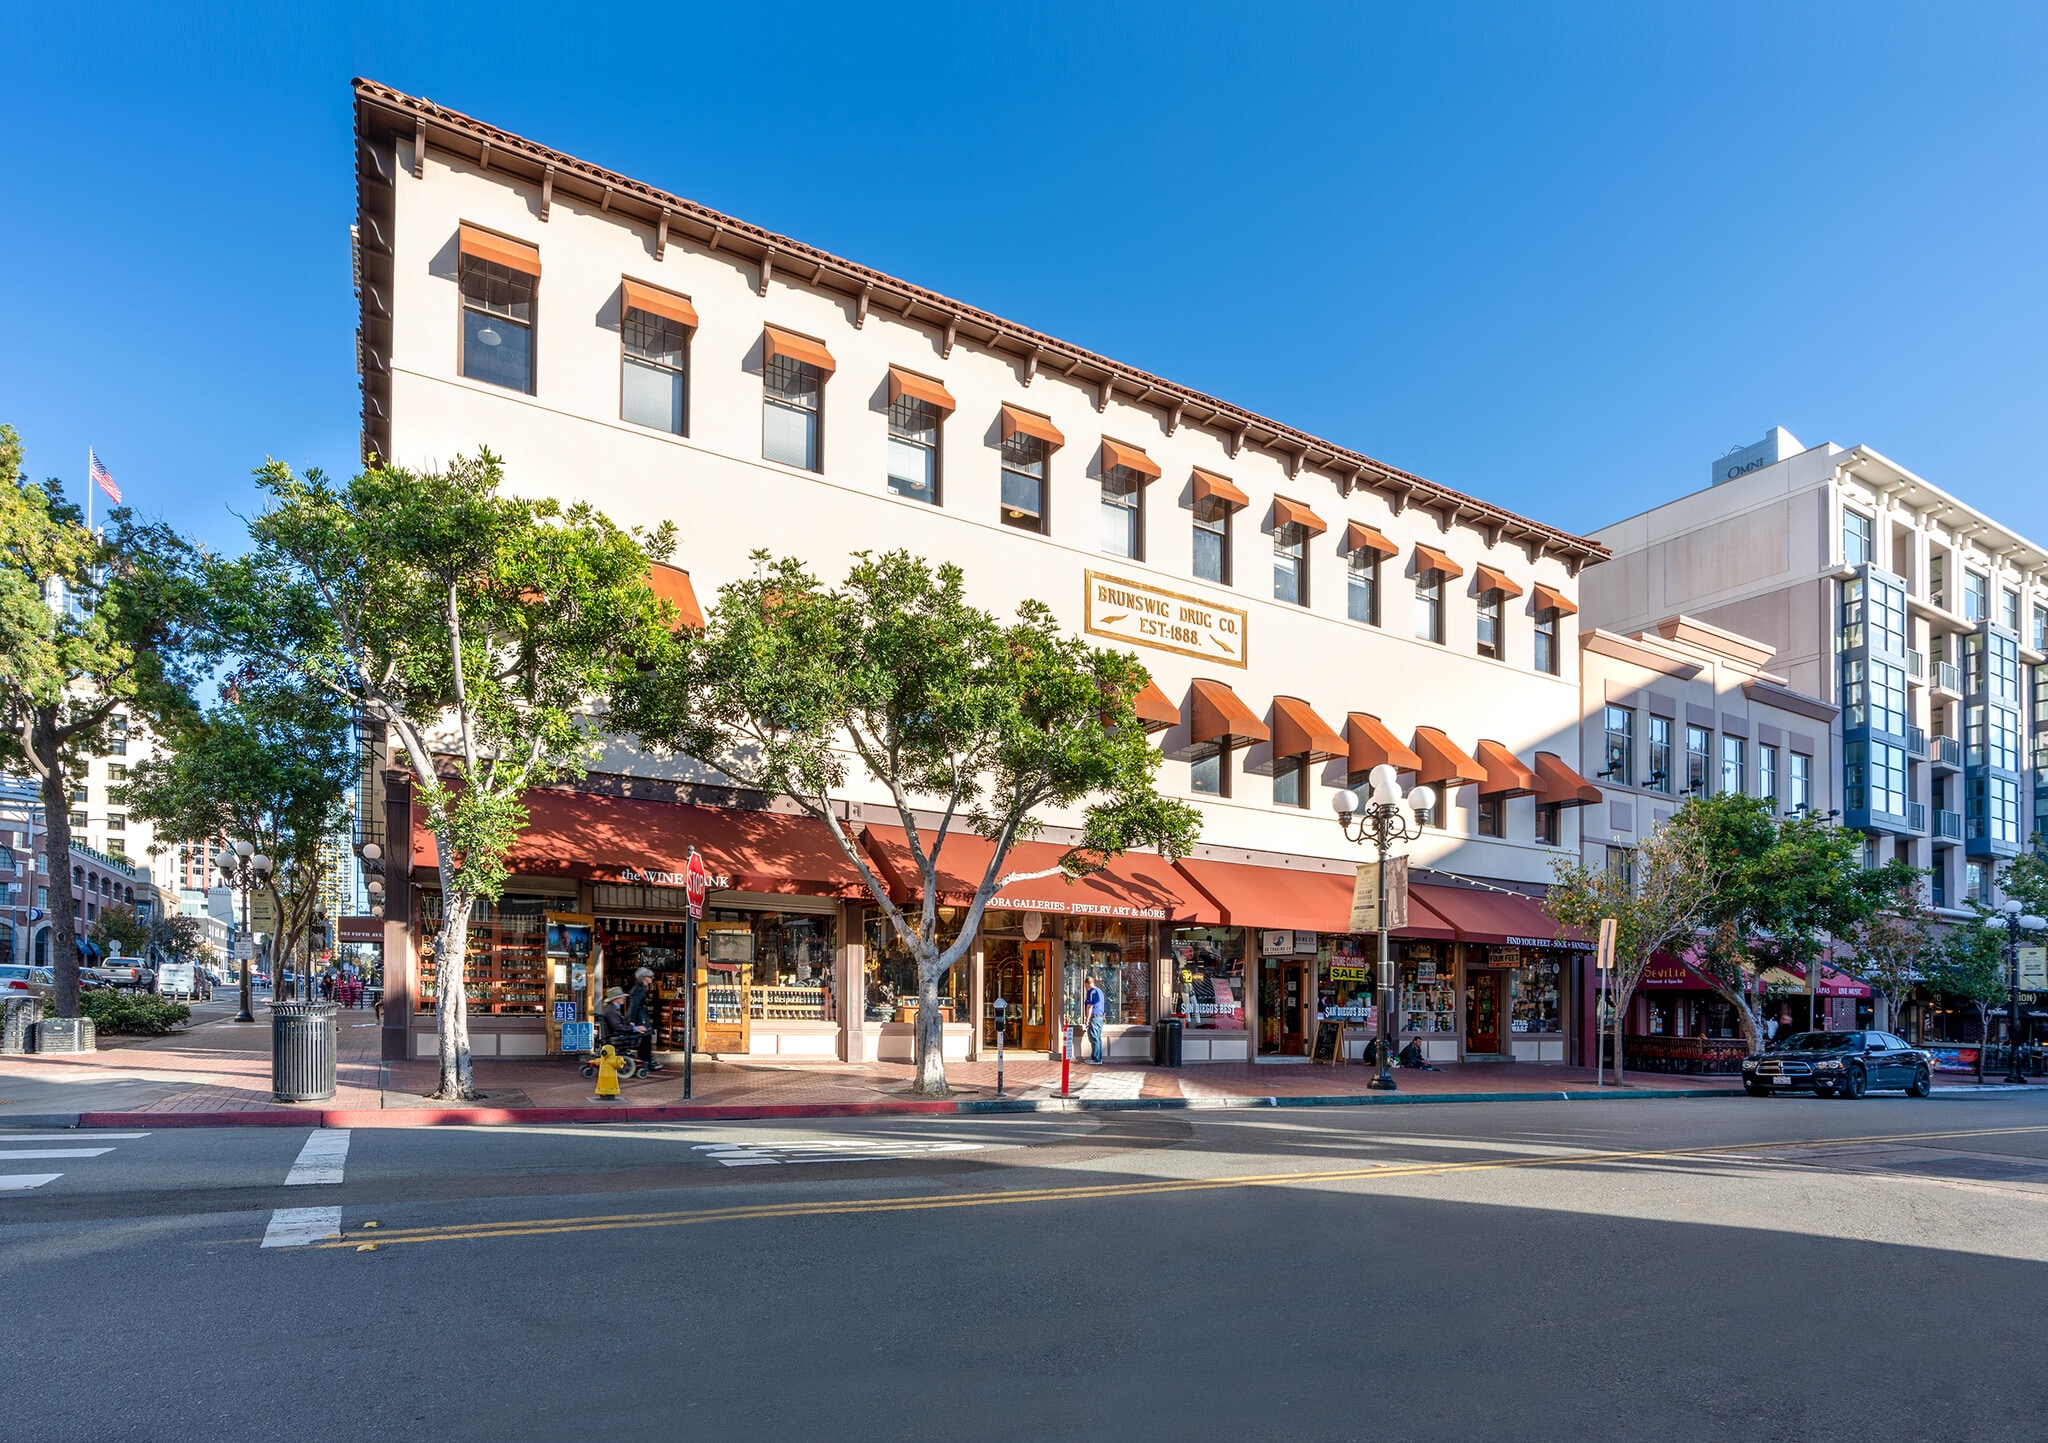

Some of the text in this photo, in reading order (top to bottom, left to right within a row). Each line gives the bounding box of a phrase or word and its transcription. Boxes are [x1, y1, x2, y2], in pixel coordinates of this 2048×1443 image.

[1727, 457, 1764, 479] OMNI
[1098, 585, 1238, 635] BRUNSWIG DRUG CO.
[621, 869, 641, 881] the
[644, 870, 684, 885] WINE
[688, 869, 704, 895] STOP
[1013, 898, 1065, 911] GALLERIES
[1071, 903, 1112, 915] JEWELRY
[1113, 906, 1131, 916] ART
[1131, 907, 1139, 917] &
[1139, 908, 1166, 919] MORE
[1506, 936, 1521, 945] FIND
[1521, 938, 1537, 946] YOUR
[1536, 939, 1551, 947] FEET
[1553, 940, 1568, 948] SOCK
[1571, 941, 1591, 950] SANDAL
[1331, 955, 1365, 967] STORE CLOSING
[1332, 968, 1364, 978] SALE
[1815, 987, 1863, 996] TAPAS LIVE MUSIC
[1181, 1003, 1236, 1015] SAN DIEGO'S BEST
[1325, 1006, 1372, 1017] SAN DIEGO'S BEST
